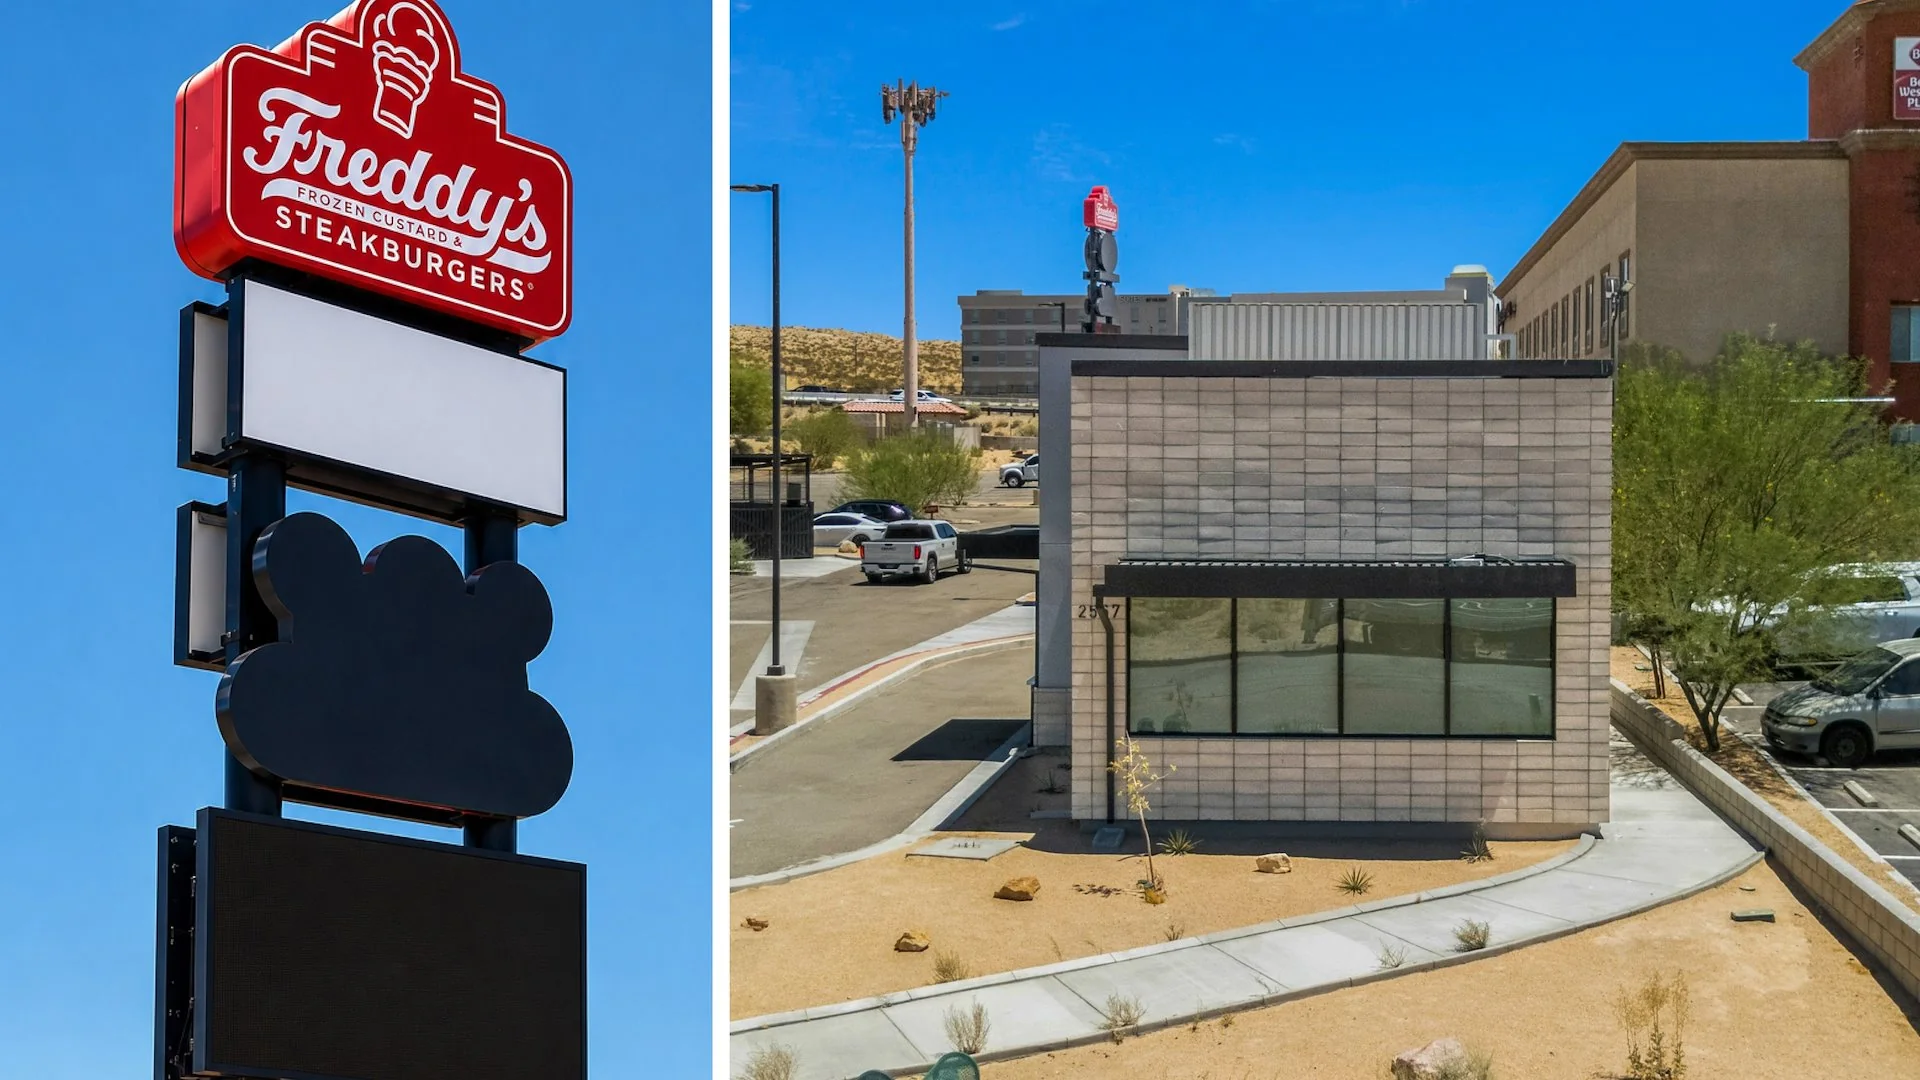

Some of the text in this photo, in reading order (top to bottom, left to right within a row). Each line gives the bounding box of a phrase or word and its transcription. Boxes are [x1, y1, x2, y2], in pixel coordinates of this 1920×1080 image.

[243, 87, 549, 258] Freddy's
[297, 186, 463, 249] FROZEN CUSTARD &
[1078, 604, 1120, 618] 257
